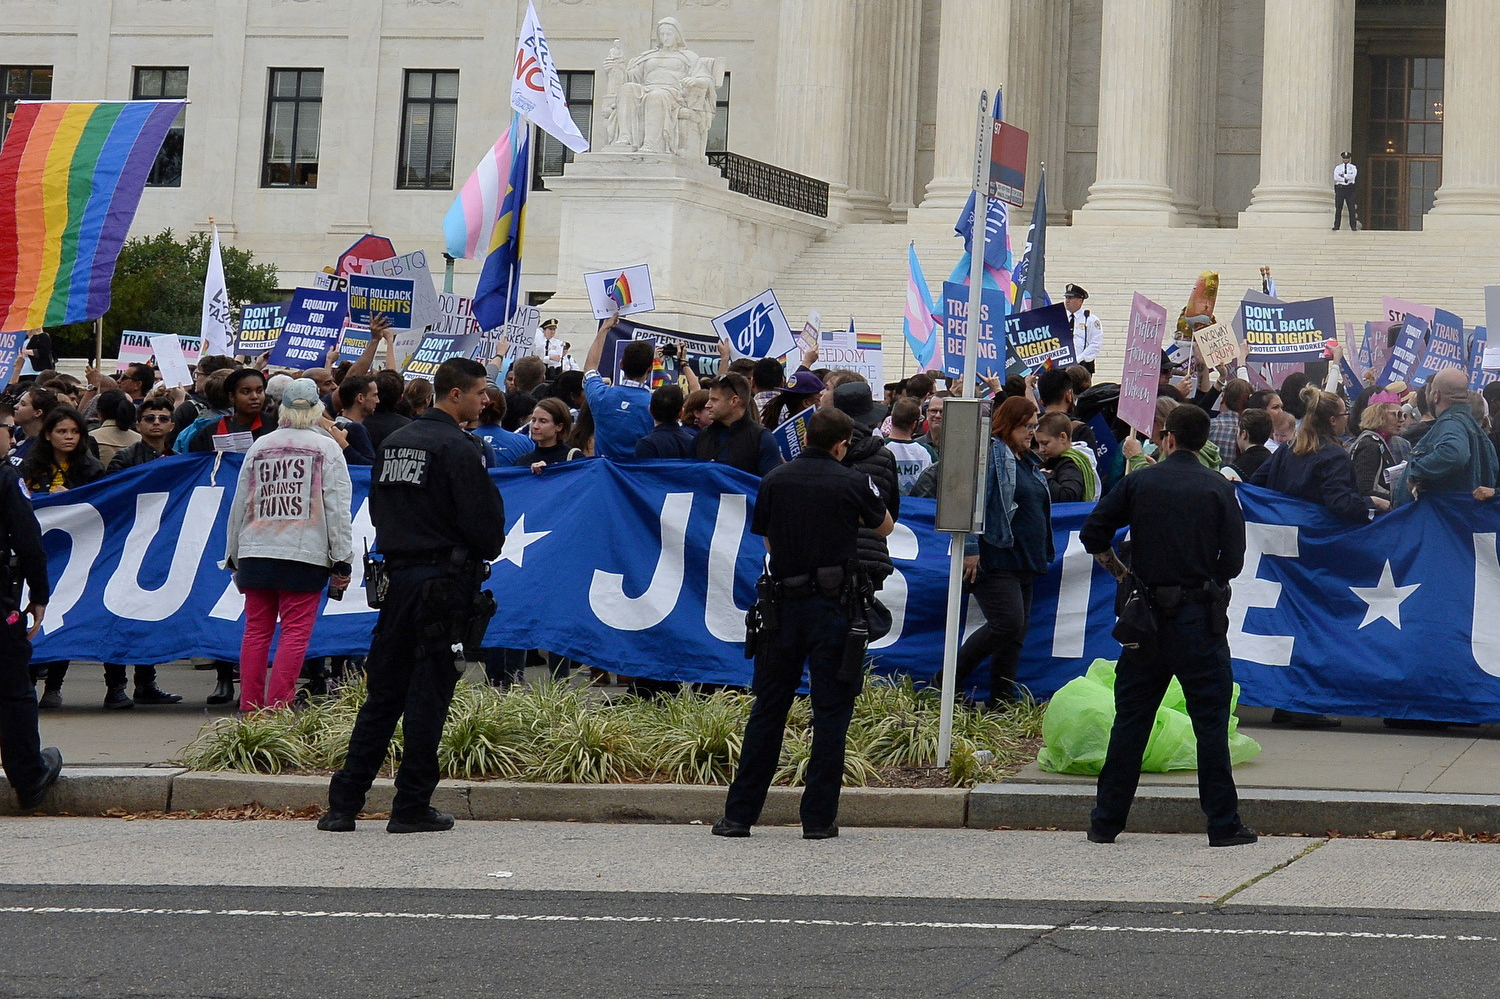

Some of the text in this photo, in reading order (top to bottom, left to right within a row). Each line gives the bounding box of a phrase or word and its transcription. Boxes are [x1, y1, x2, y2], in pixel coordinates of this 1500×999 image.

[342, 255, 376, 279] ST
[351, 286, 411, 301] DON'T ROLLBACK
[244, 305, 281, 319] DON'T
[302, 298, 338, 312] EQUALITY
[351, 296, 411, 314] OUR RIGHTS
[947, 299, 989, 321] TRAS
[1245, 305, 1284, 320] DON'T
[242, 319, 271, 330] ROLL
[308, 313, 325, 324] FOR
[1246, 318, 1315, 332] ROLL BACK
[241, 330, 266, 341] OUR
[285, 322, 339, 339] LGBTQ PEOPLE
[736, 302, 775, 357] aft
[1018, 325, 1052, 345] BACK
[1200, 324, 1229, 344] NORWAY
[1246, 330, 1323, 344] OUR RIGHTS
[1435, 322, 1460, 343] TRANS
[288, 336, 299, 346] NO
[422, 338, 454, 351] DON'T
[1208, 336, 1230, 351] HATES
[1250, 345, 1277, 353] PROTECT
[1278, 344, 1298, 352] LGBTQ
[285, 348, 319, 362] NO LESS
[414, 350, 442, 362] ROLL
[1207, 343, 1235, 363] TRUMP
[1429, 339, 1462, 360] PEOPLE
[407, 361, 433, 373] OUR
[397, 447, 427, 461] CAPITOL
[259, 459, 305, 482] GAYS
[260, 482, 304, 498] AGAINST
[259, 496, 303, 518] GUNS
